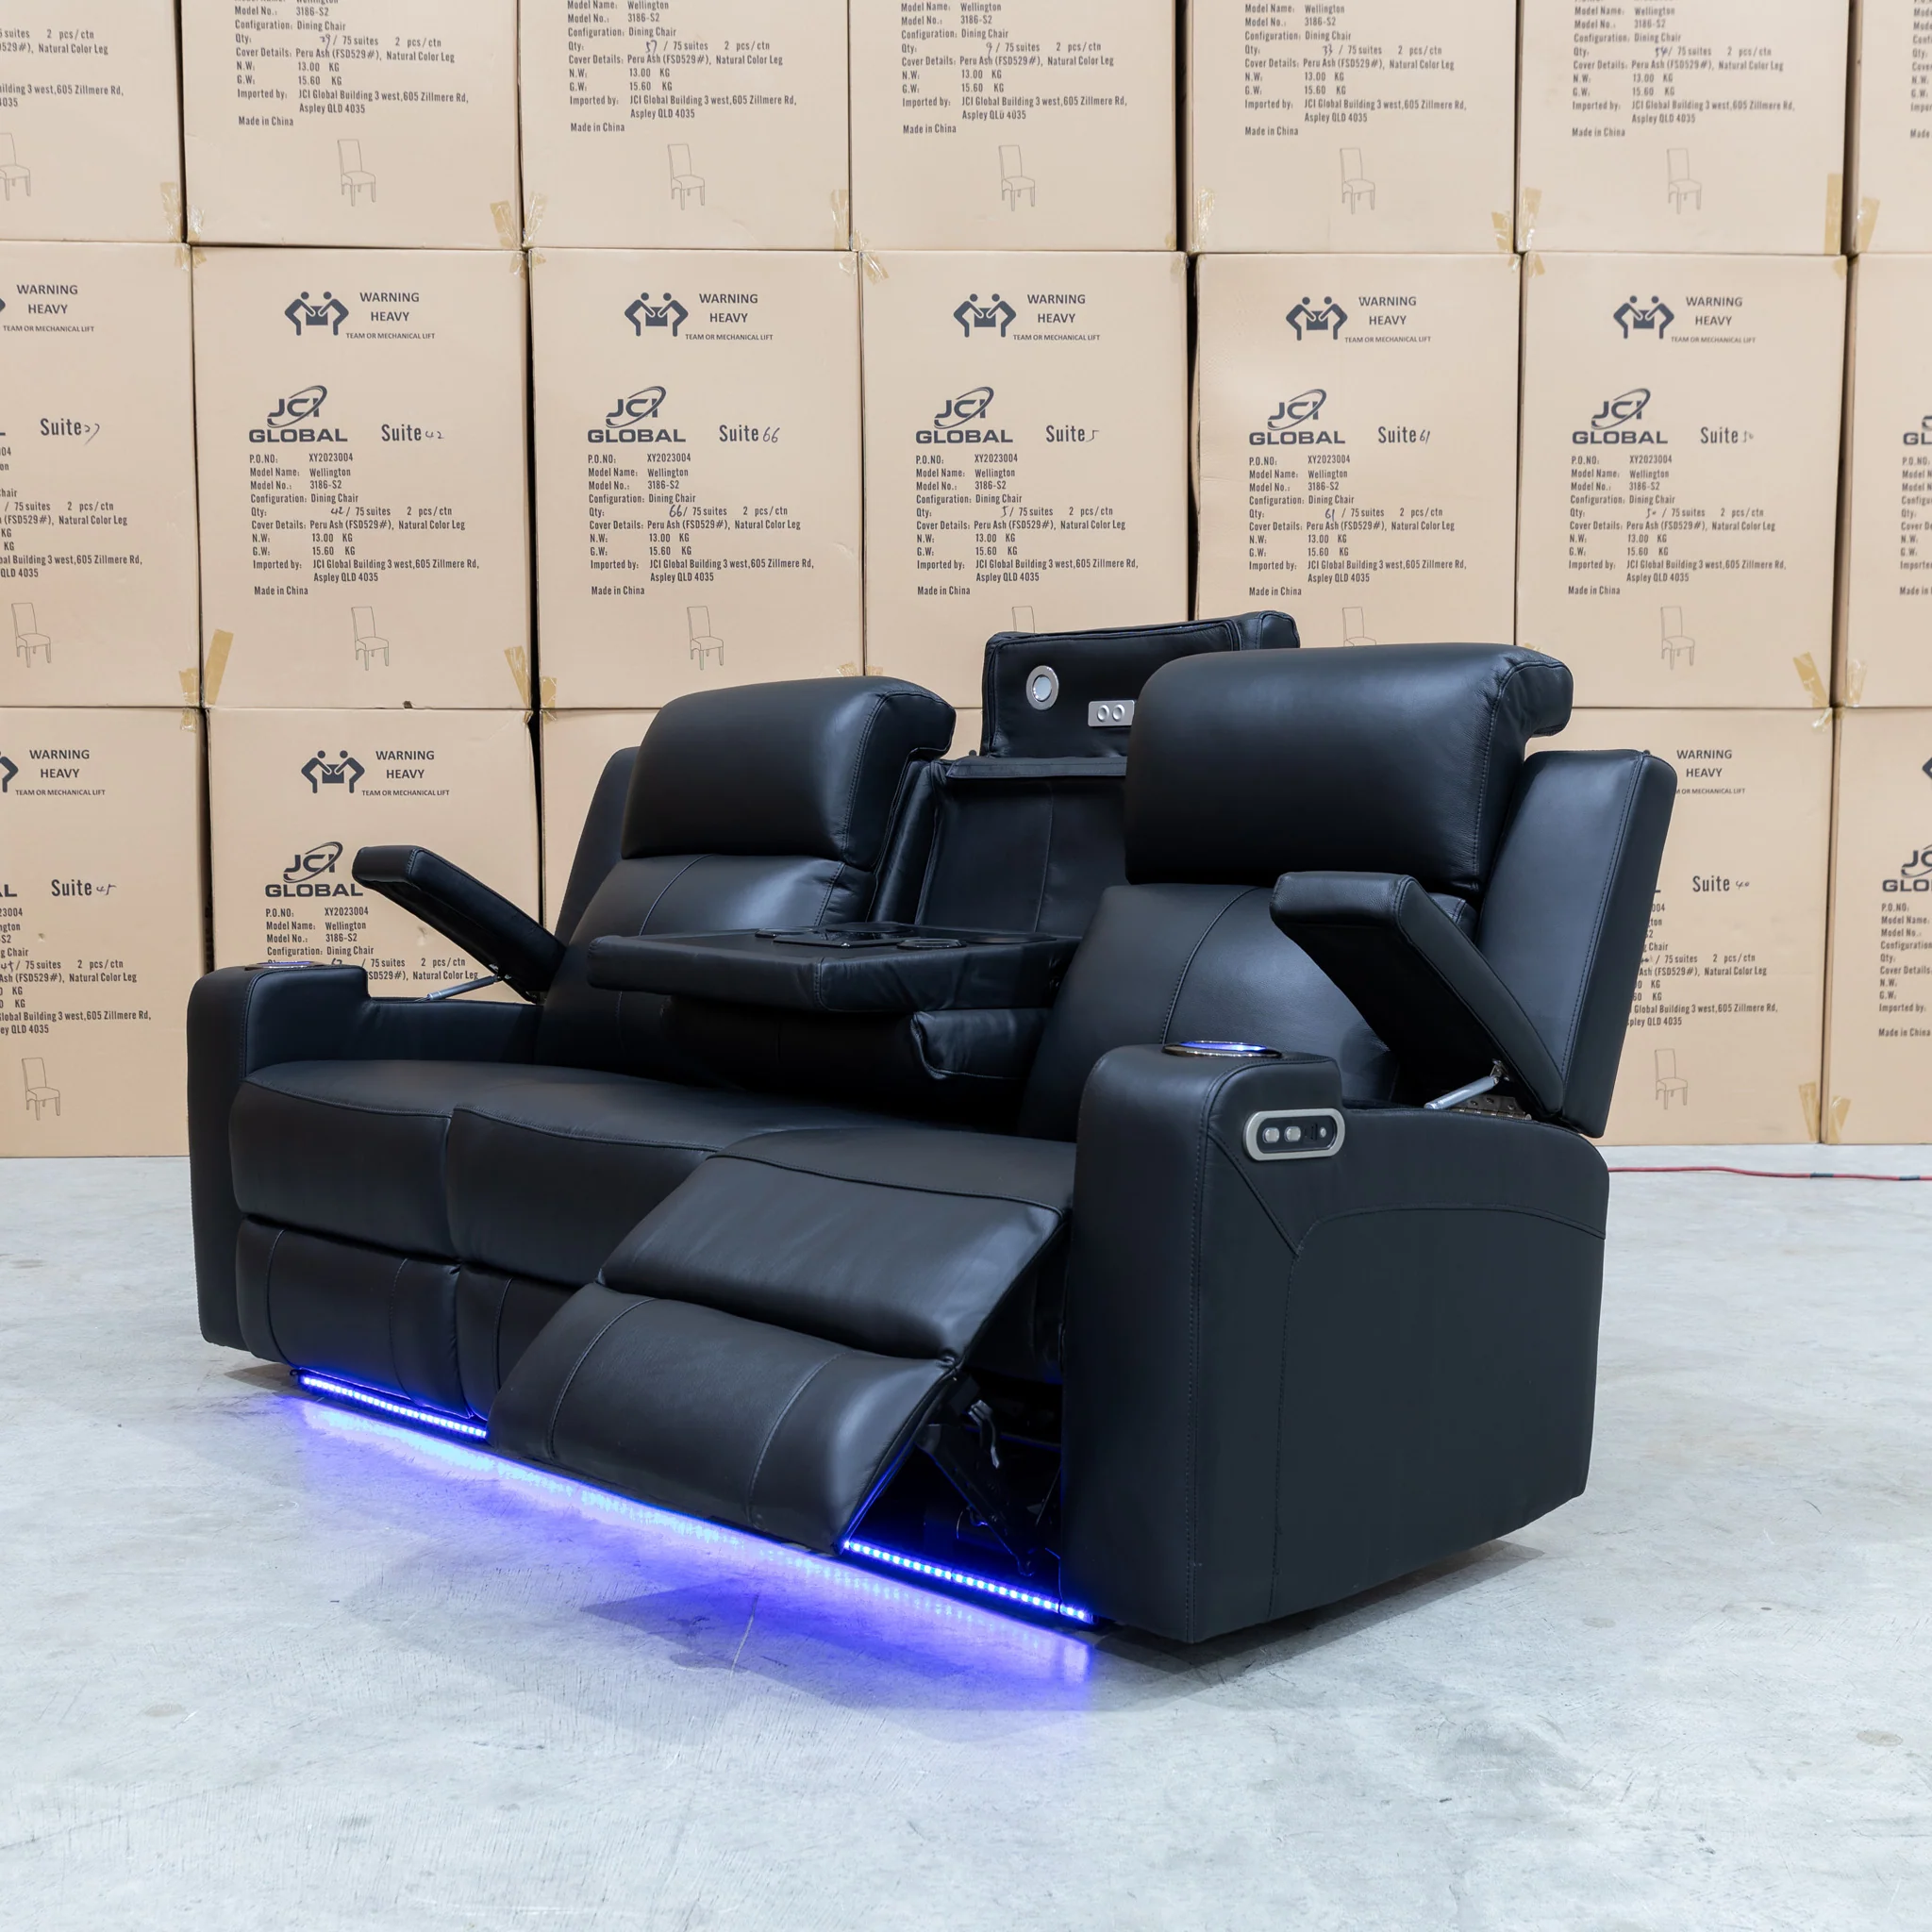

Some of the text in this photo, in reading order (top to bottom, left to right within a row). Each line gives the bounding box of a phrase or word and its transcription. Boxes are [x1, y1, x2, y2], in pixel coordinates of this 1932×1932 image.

[901, 3, 924, 11] Model
[960, 2, 1002, 13] Wellington
[1246, 17, 1268, 26] Model
[1305, 17, 1337, 26] 3186-S2
[39, 43, 108, 55] Natural Color Leg
[664, 41, 669, 50] /
[674, 41, 682, 50] 75
[684, 41, 708, 50] suites
[724, 41, 729, 50] 2
[737, 41, 771, 52] pcs/ctn
[1305, 72, 1324, 82] 13.00
[1334, 72, 1344, 81] KG
[300, 103, 365, 114] Aspley QLD 4035
[239, 115, 293, 125] Made in China
[16, 285, 78, 294] WARNING
[359, 292, 420, 302] WARNING
[699, 293, 758, 304] WARNING
[1027, 294, 1086, 304] WARNING
[1359, 297, 1417, 307] WARNING
[1687, 296, 1743, 306] WARNING
[28, 304, 68, 313] HEAVY
[371, 311, 409, 321] HEAVY
[709, 313, 748, 322] HEAVY
[1038, 313, 1075, 323] HEAVY
[1370, 316, 1407, 325] HEAVY
[1696, 316, 1734, 325] HEAVY
[40, 418, 81, 436] Suite
[249, 428, 348, 442] GLOBAL
[381, 424, 421, 441] Suite
[588, 428, 686, 442] GLOBAL
[719, 425, 780, 443] Suite 66
[916, 429, 1013, 443] GLOBAL
[1045, 425, 1084, 442] Suite
[1250, 431, 1345, 444] GLOBAL
[1377, 426, 1416, 443] Suite
[1573, 430, 1668, 444] GLOBAL
[1700, 426, 1738, 444] Suite
[647, 453, 691, 462] XY2023004
[589, 468, 611, 476] Model
[647, 468, 689, 478] Wellington
[590, 481, 611, 490] Model
[648, 480, 680, 489] 3186-S2
[649, 493, 674, 504] Dining
[675, 493, 695, 502] Chair
[590, 521, 610, 529] Cover
[648, 520, 664, 529] Peru
[666, 520, 680, 528] Ash
[682, 520, 730, 530] (FSD529#),
[735, 520, 763, 529] Natural
[766, 520, 785, 529] Color
[788, 520, 800, 530] Leg
[649, 533, 670, 542] 13.00
[679, 533, 690, 541] KG
[650, 546, 671, 555] 15.60
[682, 546, 691, 555] KG
[591, 559, 625, 571] Imported
[650, 559, 661, 569] JCI
[663, 559, 688, 568] Global
[690, 559, 722, 570] Building
[724, 559, 727, 568] 3
[730, 559, 766, 569] west,605
[768, 559, 799, 568] Zillmere
[802, 558, 814, 568] Rd,
[651, 573, 714, 583] Aspley QLD 4035
[591, 586, 645, 595] Made in China
[28, 750, 90, 759] WARNING
[375, 751, 435, 760] WARNING
[1676, 749, 1734, 759] WARNING
[41, 769, 79, 777] HEAVY
[386, 770, 425, 778] HEAVY
[1687, 768, 1723, 777] HEAVY
[51, 879, 92, 896] Suite
[1691, 874, 1729, 892] Suite
[266, 883, 363, 897] GLOBAL
[325, 907, 368, 916] XY2023004
[327, 946, 351, 957] Dining
[353, 946, 374, 955] Chair
[1648, 1017, 1683, 1025] QLD 4035
